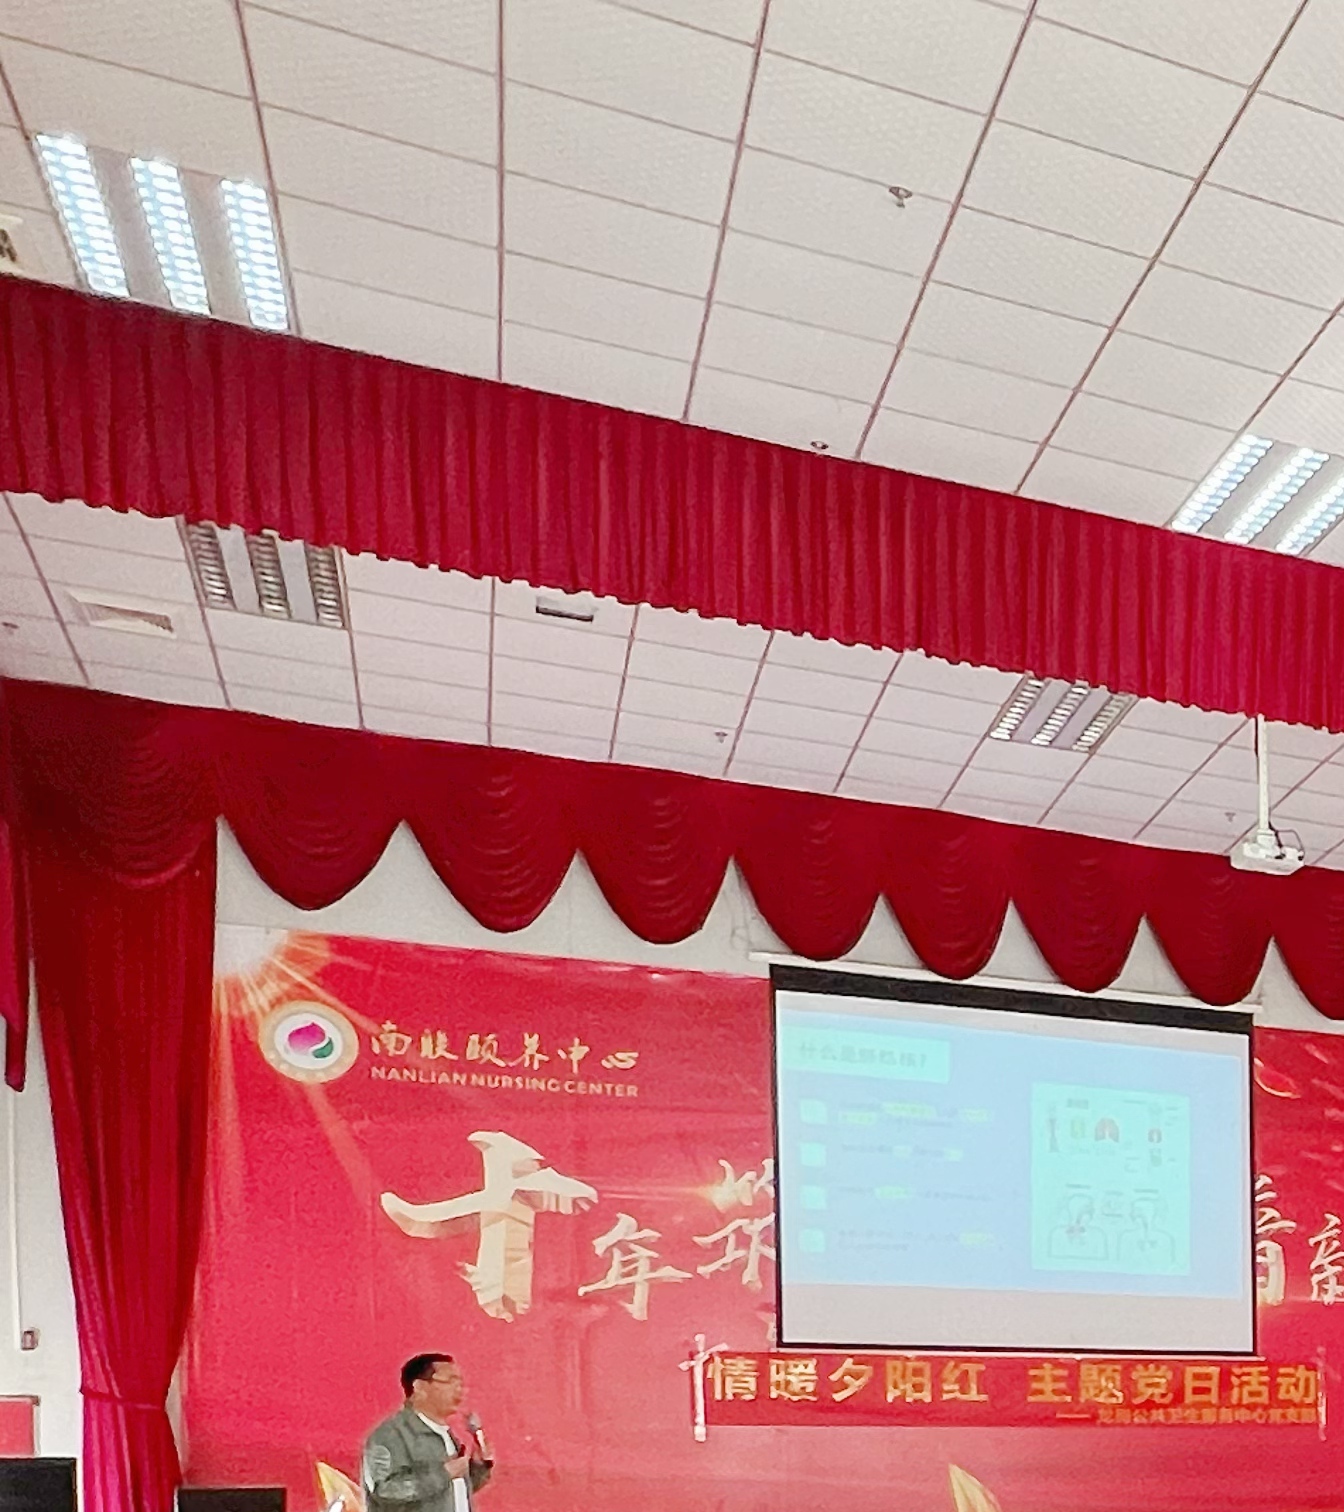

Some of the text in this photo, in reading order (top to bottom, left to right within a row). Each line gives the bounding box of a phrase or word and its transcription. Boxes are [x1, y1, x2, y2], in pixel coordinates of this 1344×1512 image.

[371, 1066, 638, 1098] NANLIAN NURSING CENTER
[707, 1356, 1317, 1404] 情暖夕阳红 主题党日活动
